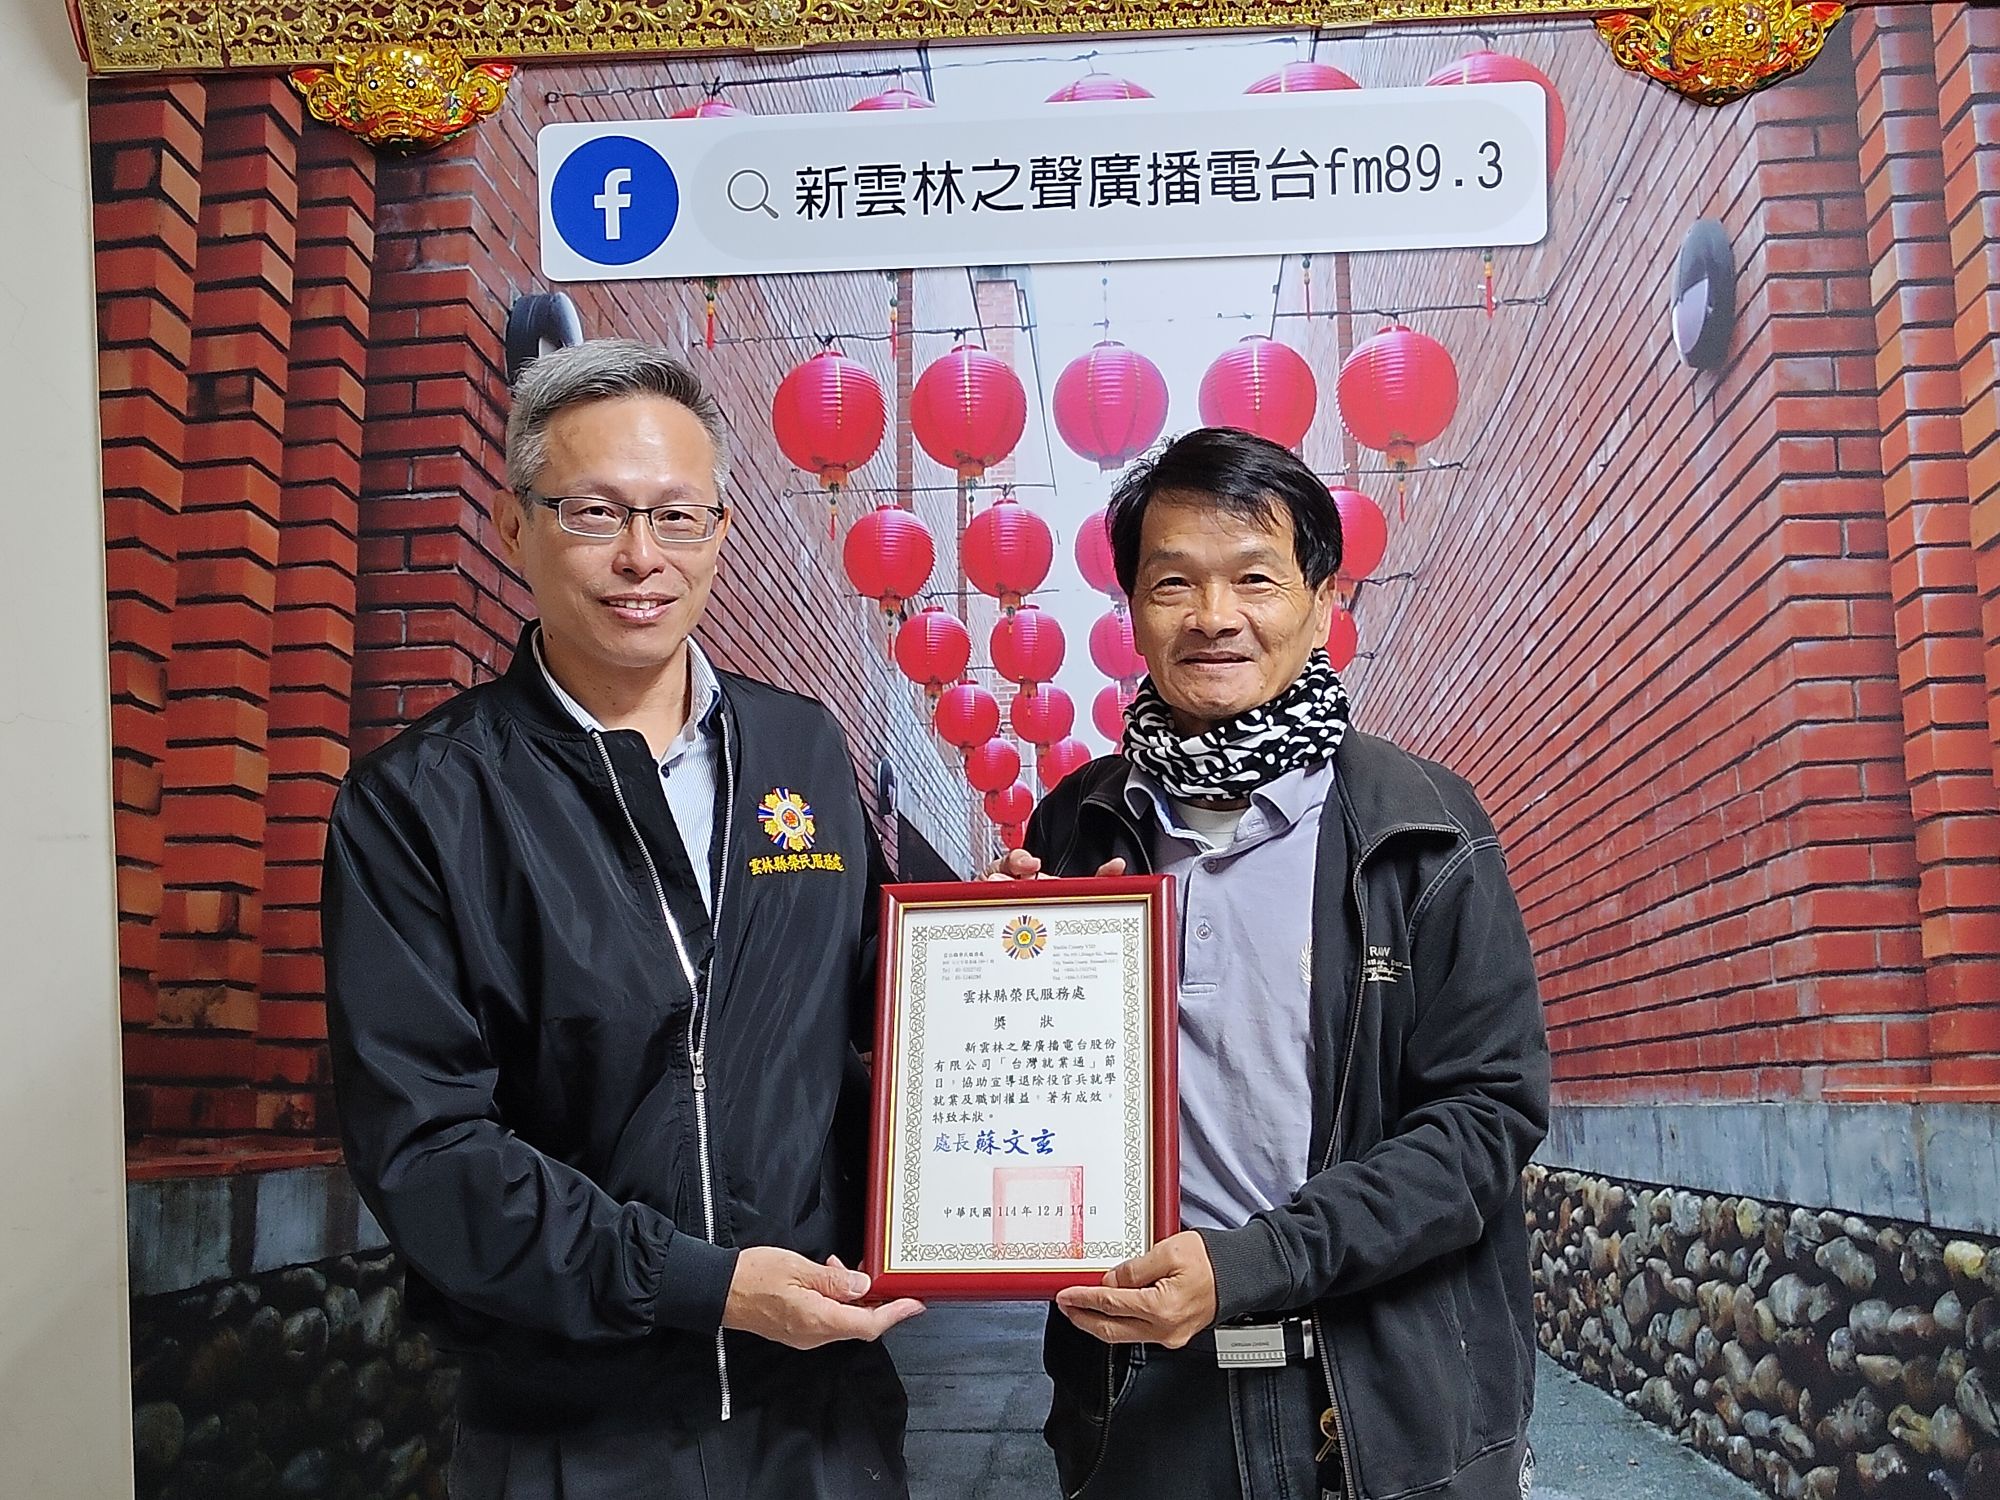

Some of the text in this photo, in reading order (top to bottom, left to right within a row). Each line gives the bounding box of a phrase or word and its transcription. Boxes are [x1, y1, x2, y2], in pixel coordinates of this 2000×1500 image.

[795, 140, 1503, 220] 新雲林之聲廣播電台fm89.3
[1368, 945, 1391, 957] RAW
[963, 985, 1086, 1004] 雲林縣榮民服務處
